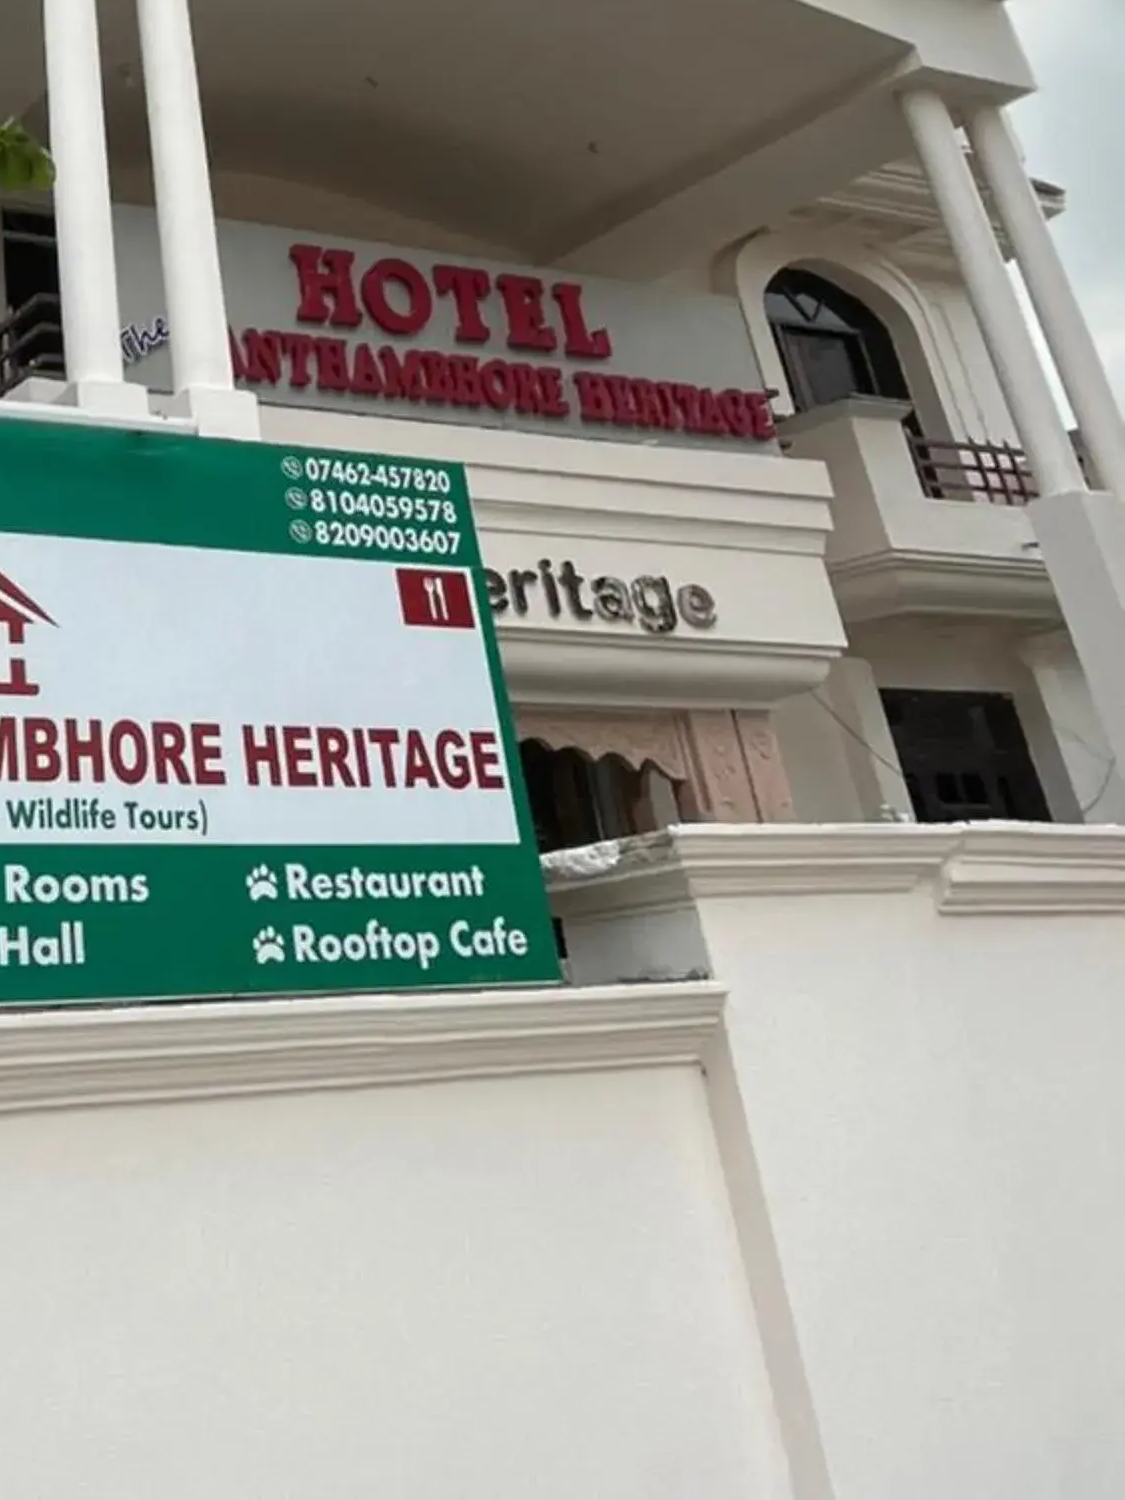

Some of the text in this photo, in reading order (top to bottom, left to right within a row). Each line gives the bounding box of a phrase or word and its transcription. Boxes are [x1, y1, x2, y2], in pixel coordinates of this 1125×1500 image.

[289, 244, 613, 359] HOTEL
[120, 316, 170, 363] The
[572, 369, 776, 440] HERITAGE
[305, 457, 451, 493] 07462-457820
[310, 488, 458, 524] 8104059578
[315, 520, 461, 555] 8209003607
[483, 557, 718, 633] eritage
[241, 724, 505, 790] HERITAGE
[5, 797, 116, 830] Wildlife
[123, 799, 208, 837] Tours)
[4, 865, 150, 903] Rooms
[285, 862, 486, 899] Restaurant
[293, 916, 528, 969] Rooftop Cafe
